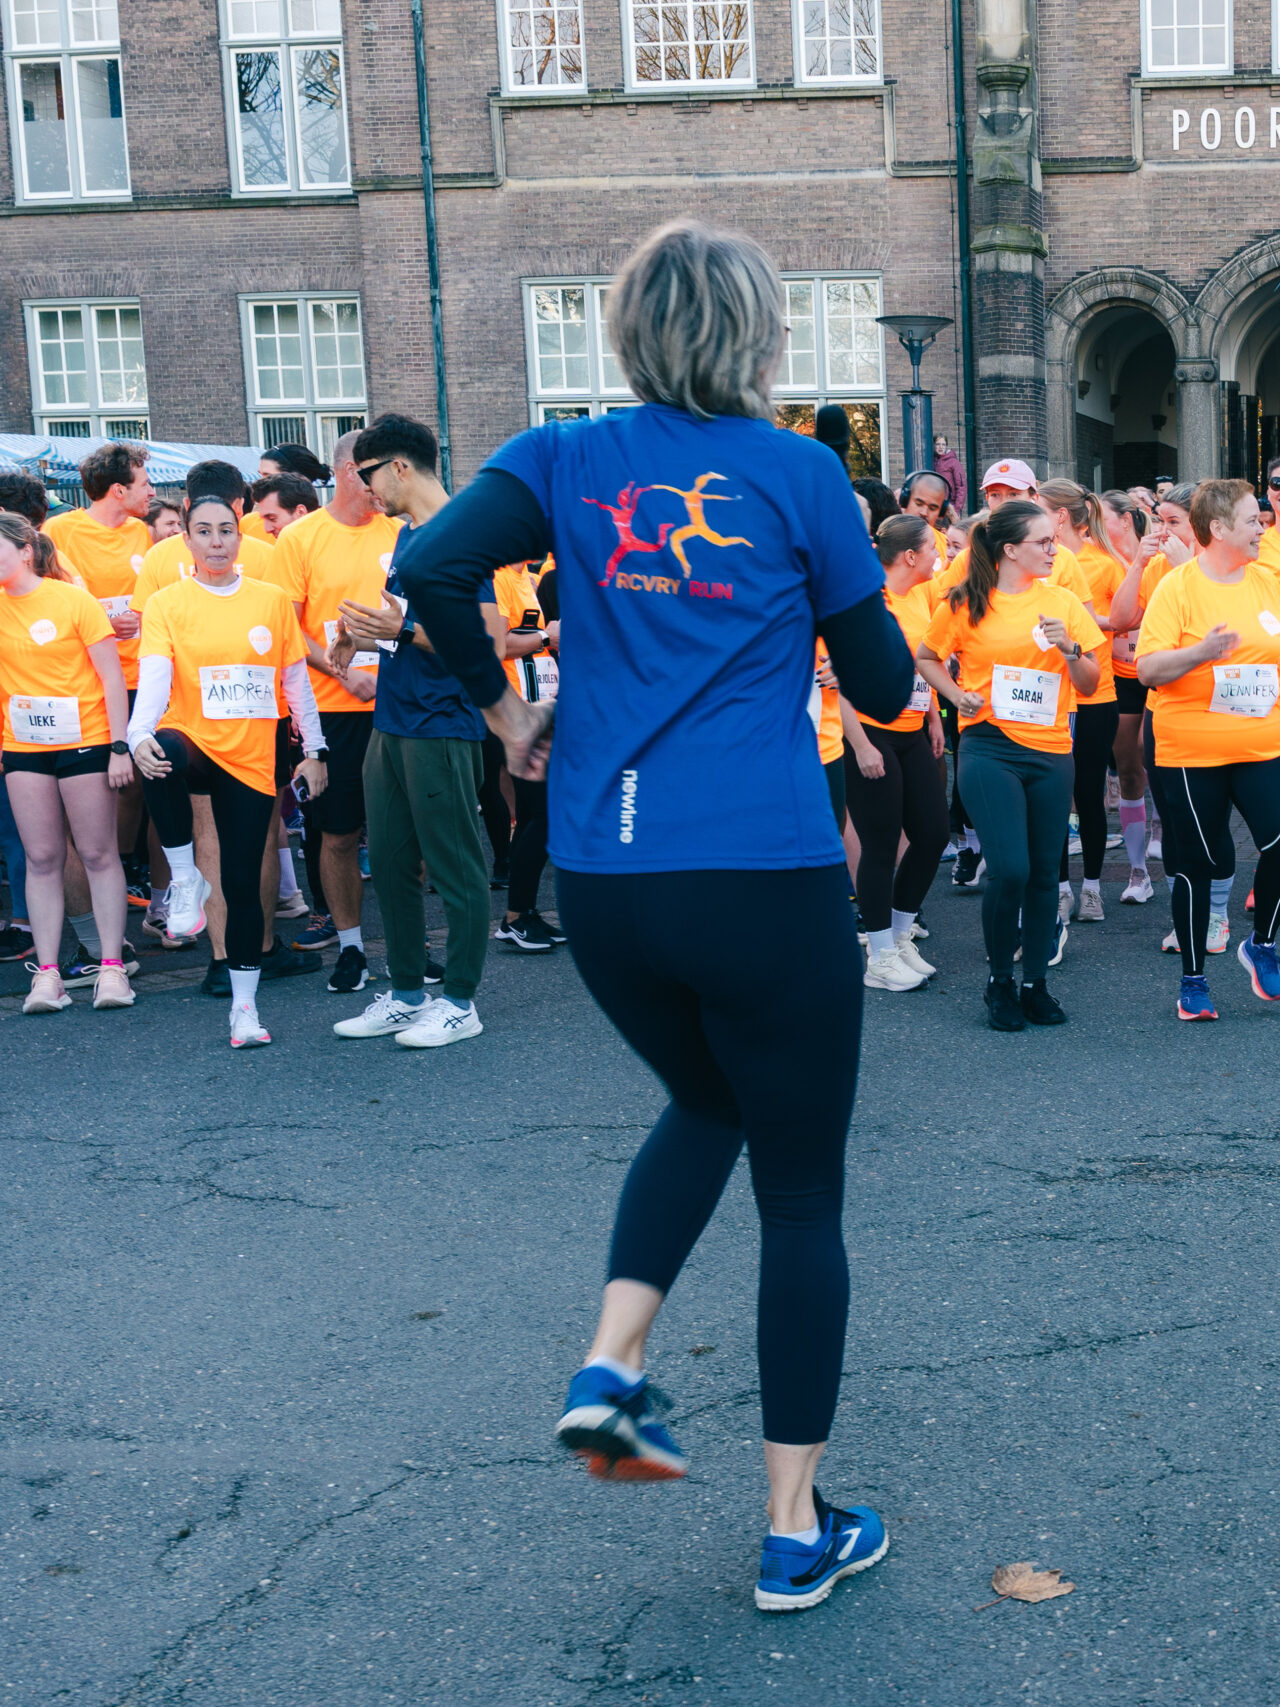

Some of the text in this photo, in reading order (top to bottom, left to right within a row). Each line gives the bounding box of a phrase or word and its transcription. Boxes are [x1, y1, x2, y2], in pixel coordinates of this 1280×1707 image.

[615, 571, 733, 600] RCVRY RUN
[207, 682, 273, 702] ANDREA
[1011, 687, 1043, 705] SARAH
[1220, 682, 1278, 699] JENNIFER
[28, 714, 56, 727] LIEKE
